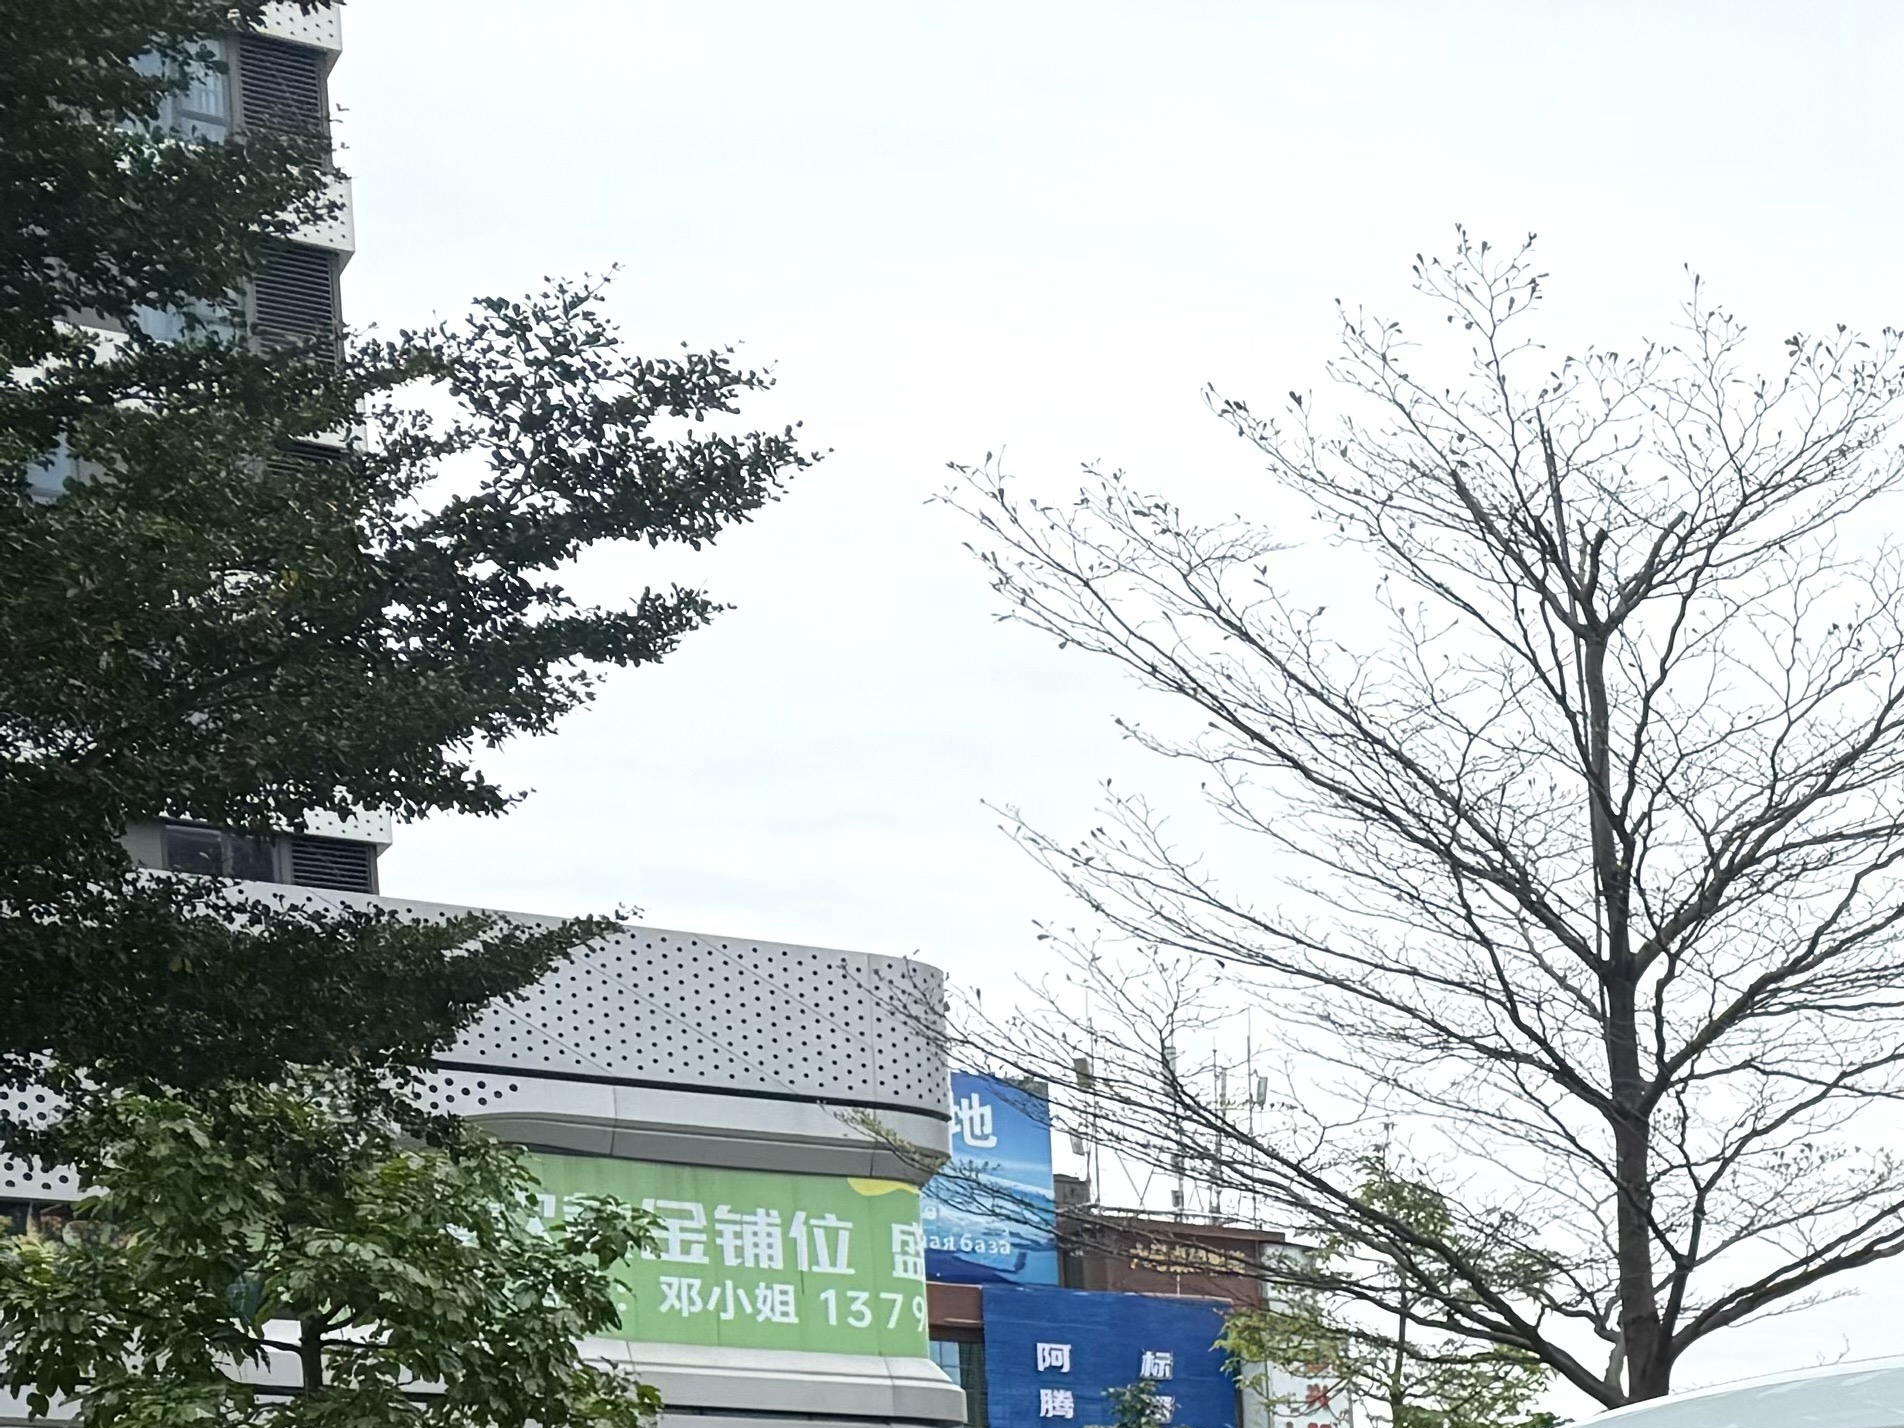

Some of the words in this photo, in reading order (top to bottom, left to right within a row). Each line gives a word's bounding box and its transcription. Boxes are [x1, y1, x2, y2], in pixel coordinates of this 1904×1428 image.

[658, 1275, 800, 1325] 邓小姐
[818, 1287, 925, 1333] 1379
